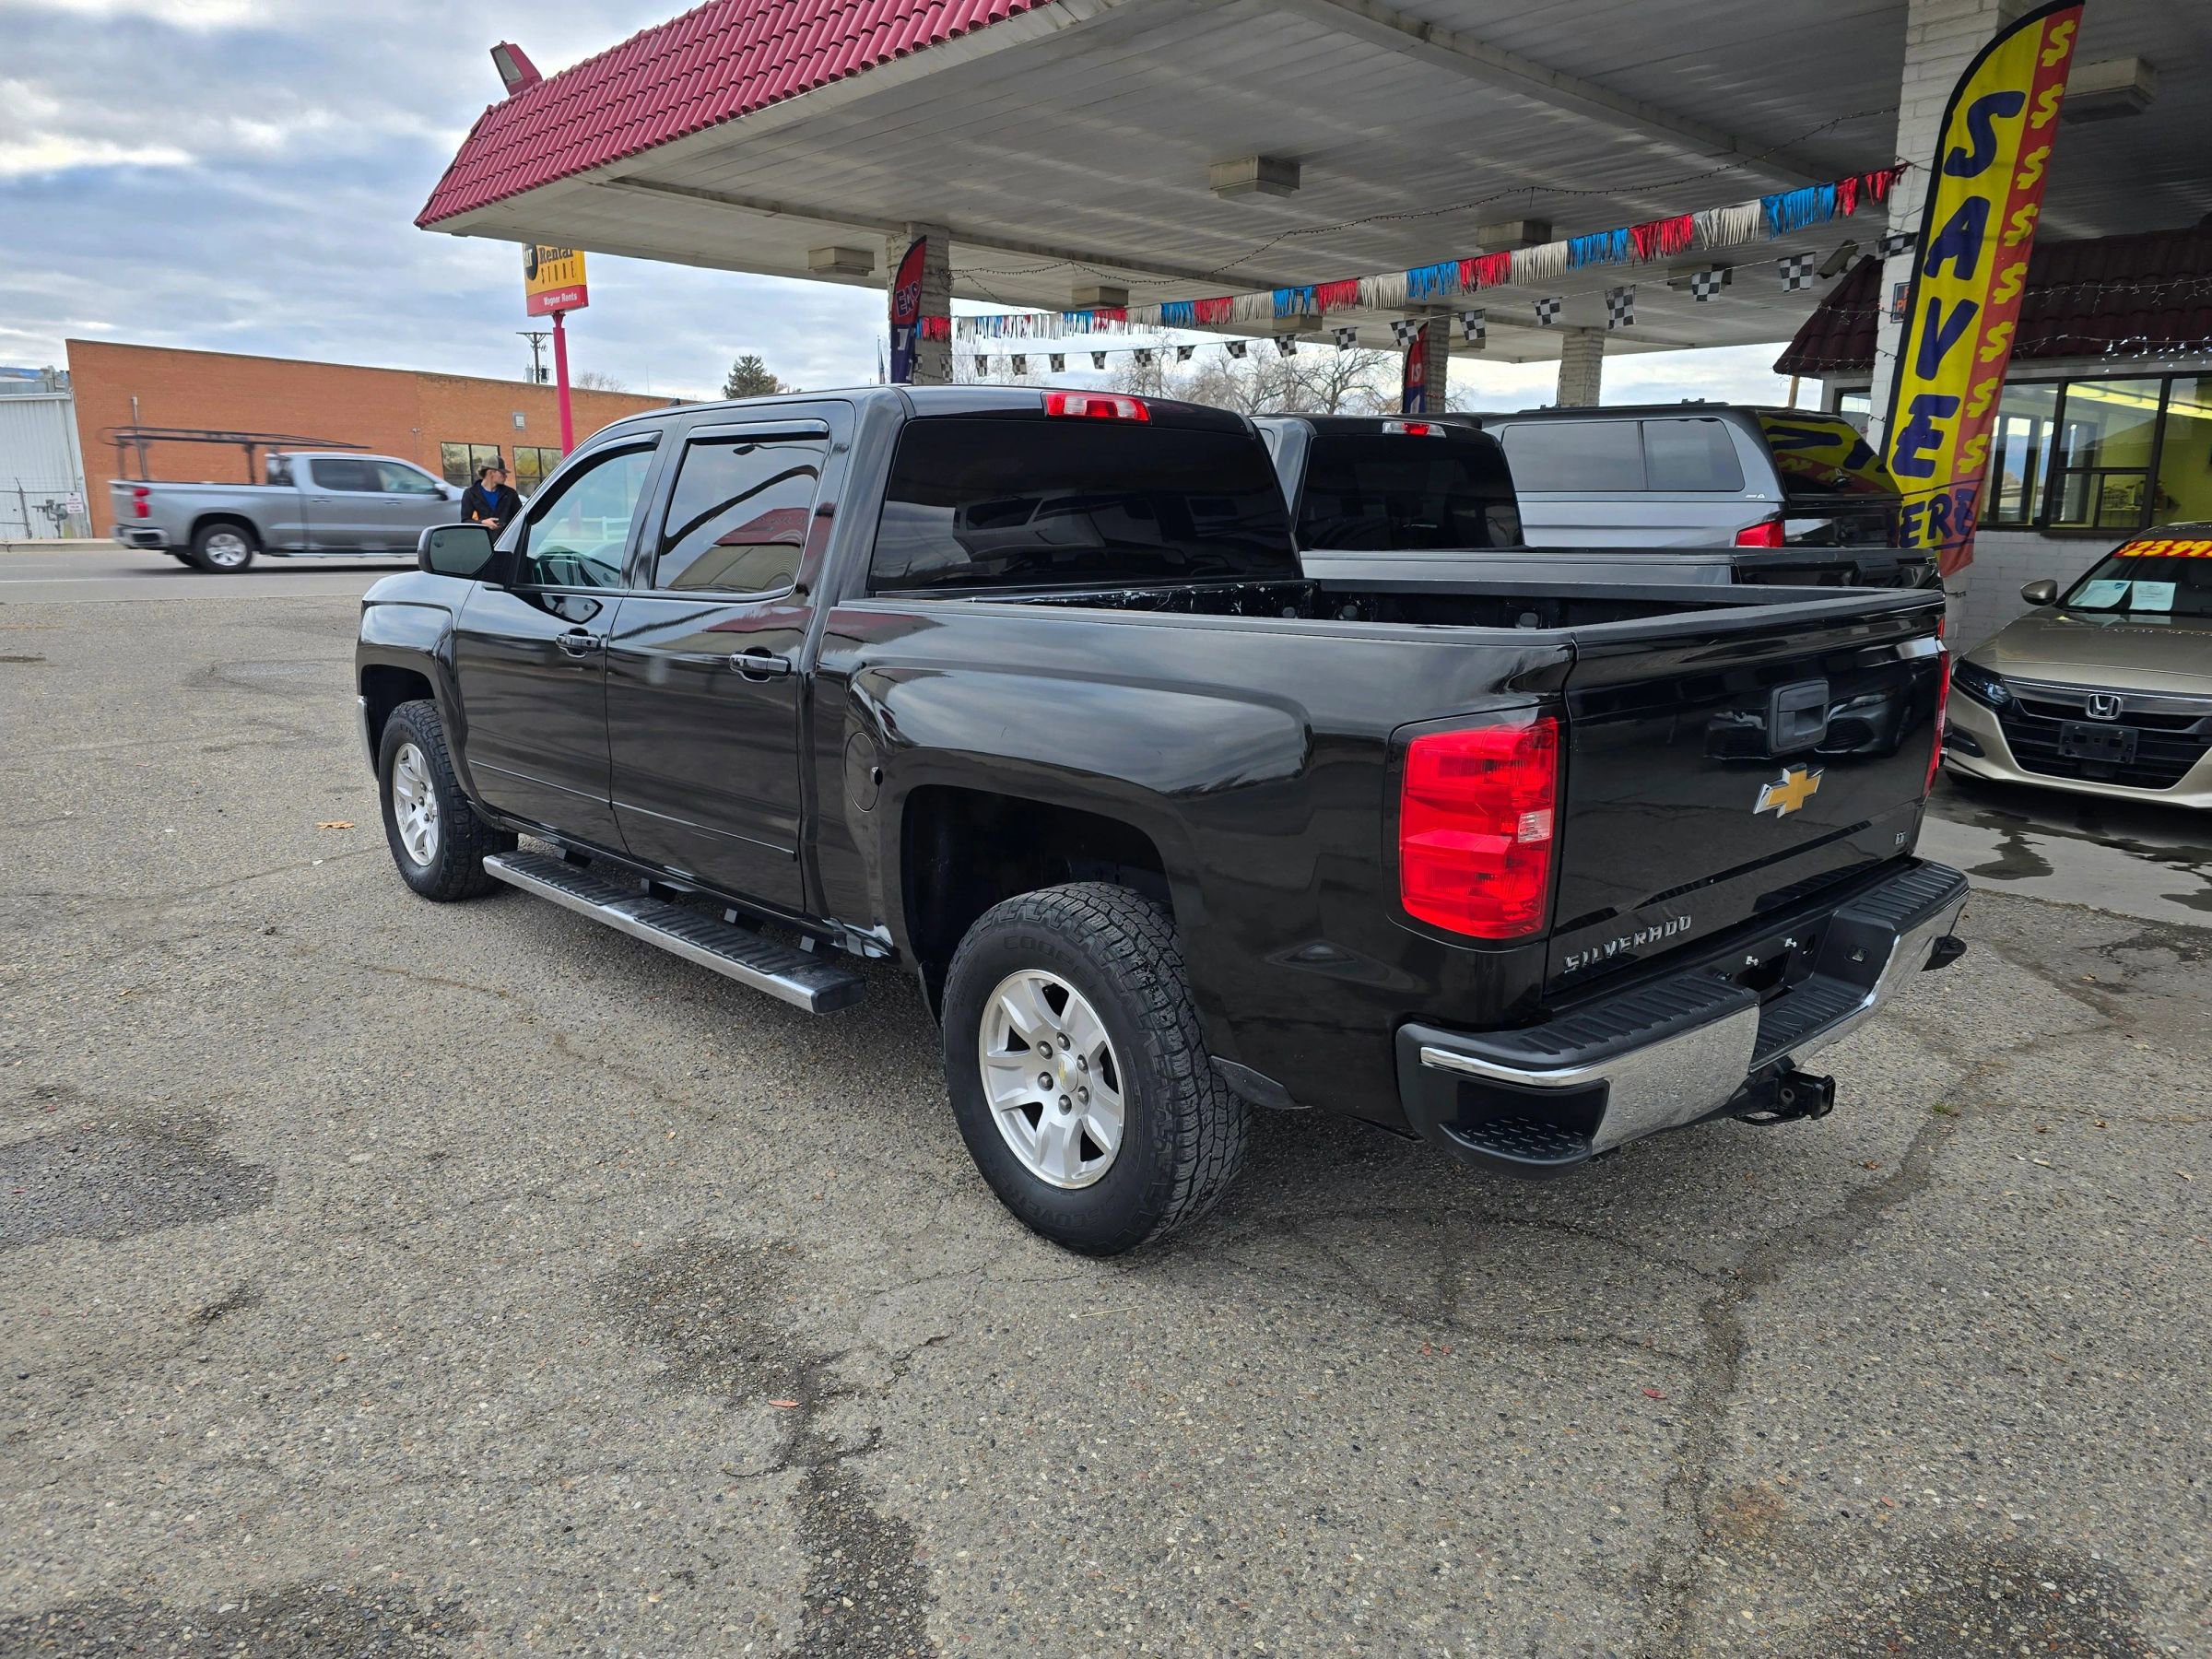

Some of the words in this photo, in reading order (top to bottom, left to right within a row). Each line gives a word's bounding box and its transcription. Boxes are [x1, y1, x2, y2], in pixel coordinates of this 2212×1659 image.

[541, 261, 575, 285] STORE
[1892, 90, 2026, 478] SAVE
[561, 292, 578, 302] Rents
[1900, 488, 1977, 548] ERE
[2118, 540, 2212, 557] $2399
[1564, 914, 1692, 973] SILVERADO
